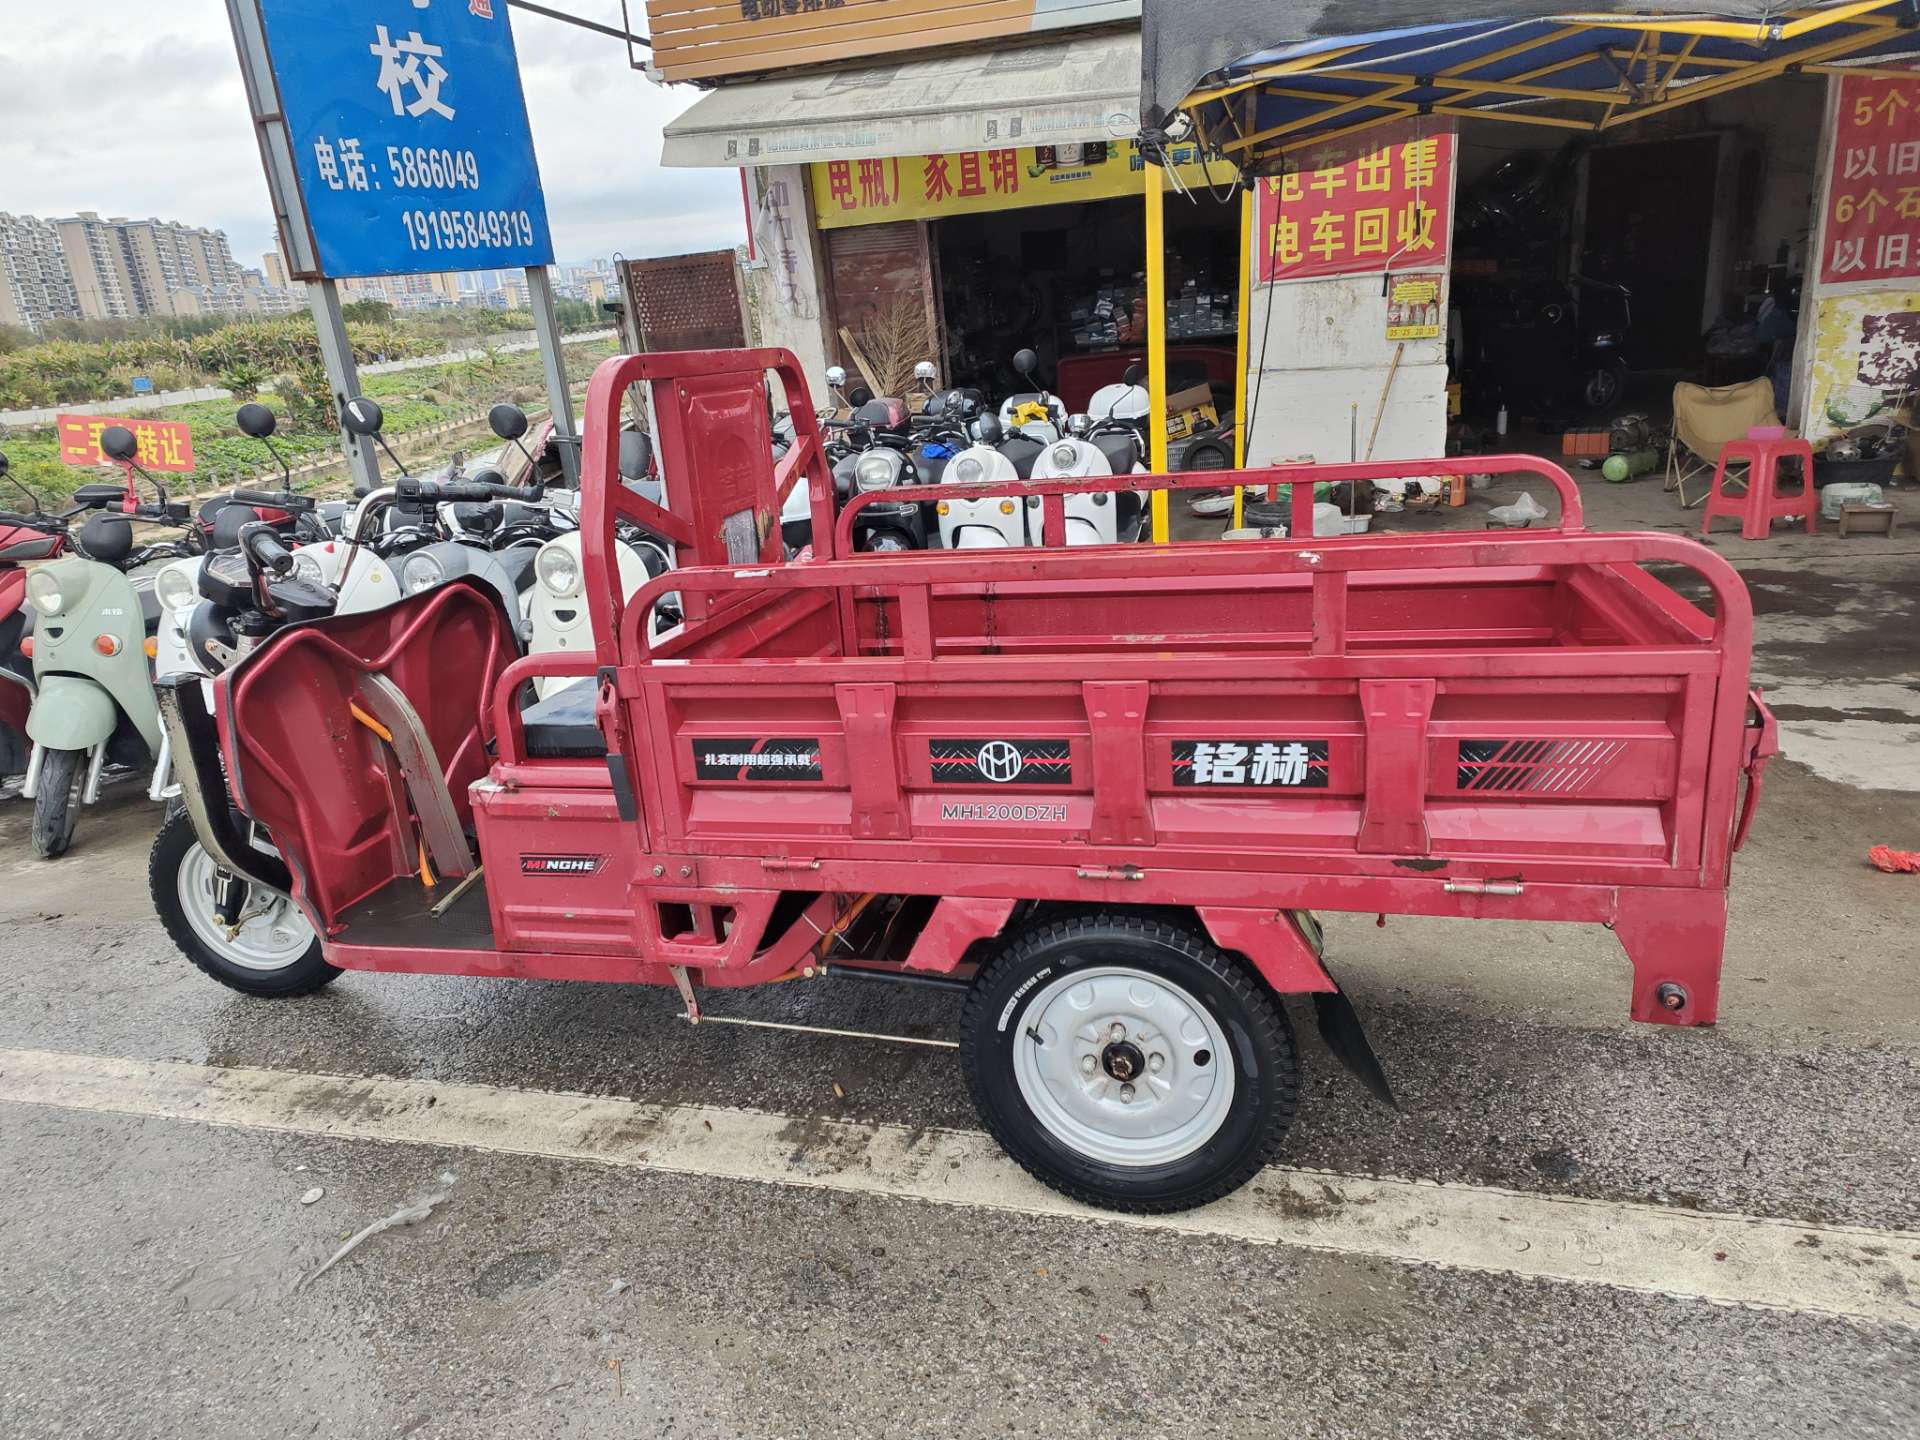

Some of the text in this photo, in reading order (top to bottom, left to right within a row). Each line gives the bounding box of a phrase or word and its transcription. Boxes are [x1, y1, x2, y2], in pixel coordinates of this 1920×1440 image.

[369, 25, 456, 121] 校
[1853, 88, 1920, 128] 5个
[402, 210, 533, 251] 19195849319
[1268, 201, 1437, 264] 电车回收
[1831, 233, 1920, 274] 以旧
[66, 421, 186, 466] 二手转让
[1191, 742, 1309, 785] 铭赫
[941, 802, 1068, 822] MH1200DZH
[526, 859, 596, 871] MINGHE
